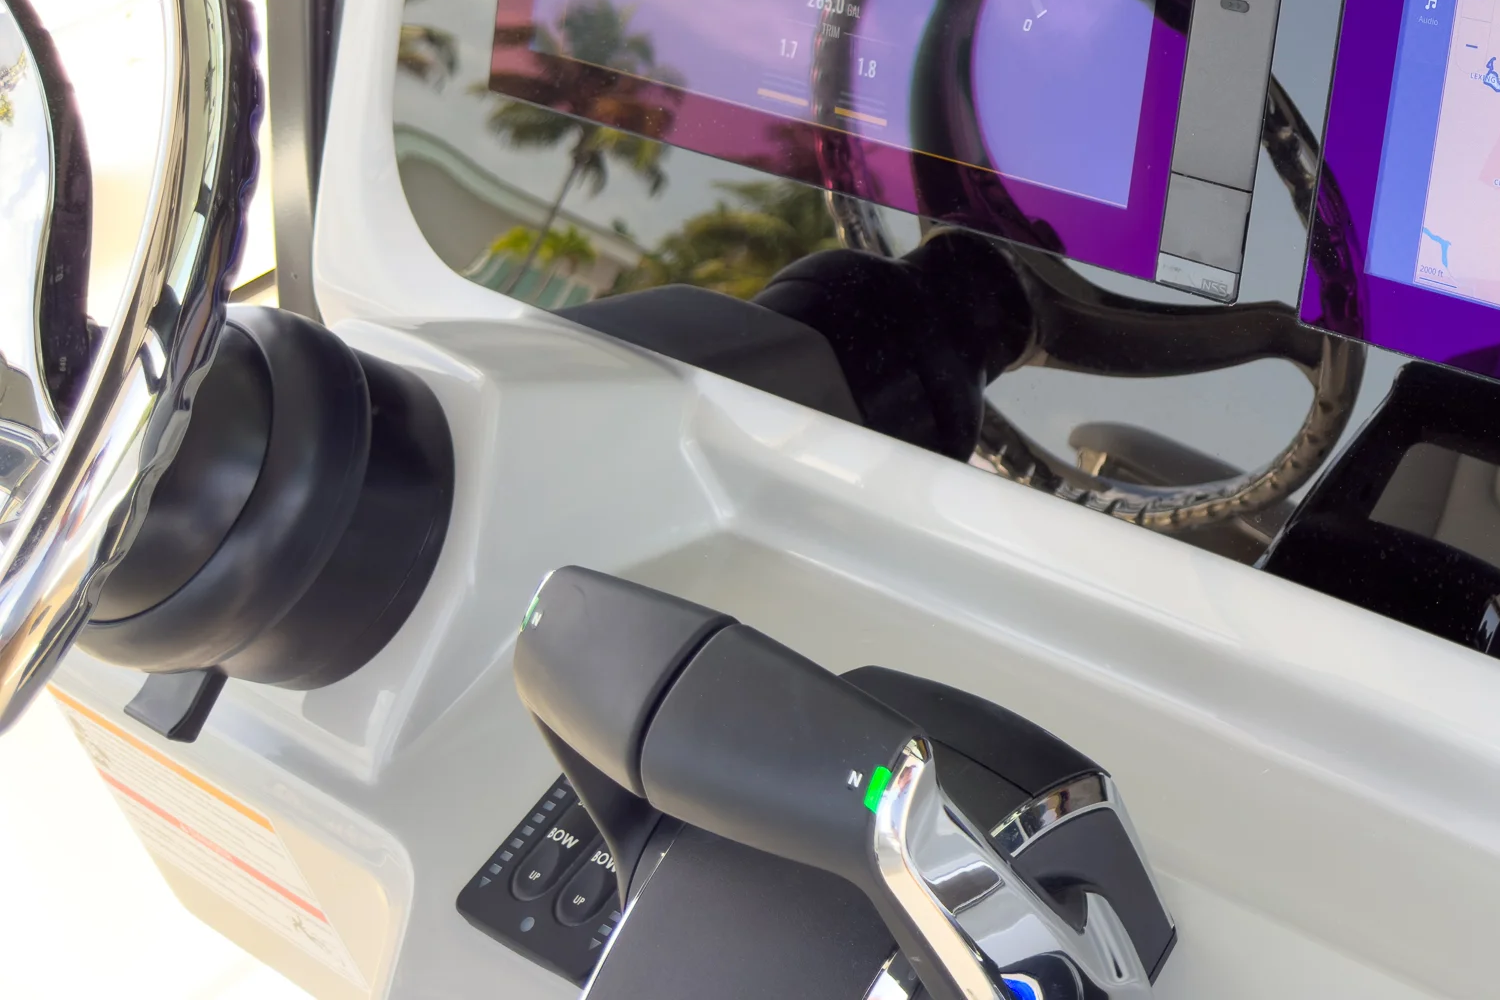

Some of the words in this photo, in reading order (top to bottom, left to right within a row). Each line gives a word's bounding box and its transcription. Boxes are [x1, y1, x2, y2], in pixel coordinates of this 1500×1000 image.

[847, 4, 861, 19] GAL
[1418, 15, 1439, 26] Audio
[822, 23, 840, 39] TRIM
[780, 39, 798, 60] 1.7
[857, 57, 877, 78] 1.8
[1420, 265, 1437, 276] 2000
[1437, 270, 1444, 278] ft
[848, 770, 863, 788] N
[547, 827, 579, 849] BOW
[528, 870, 541, 880] UP
[573, 895, 586, 905] UP
